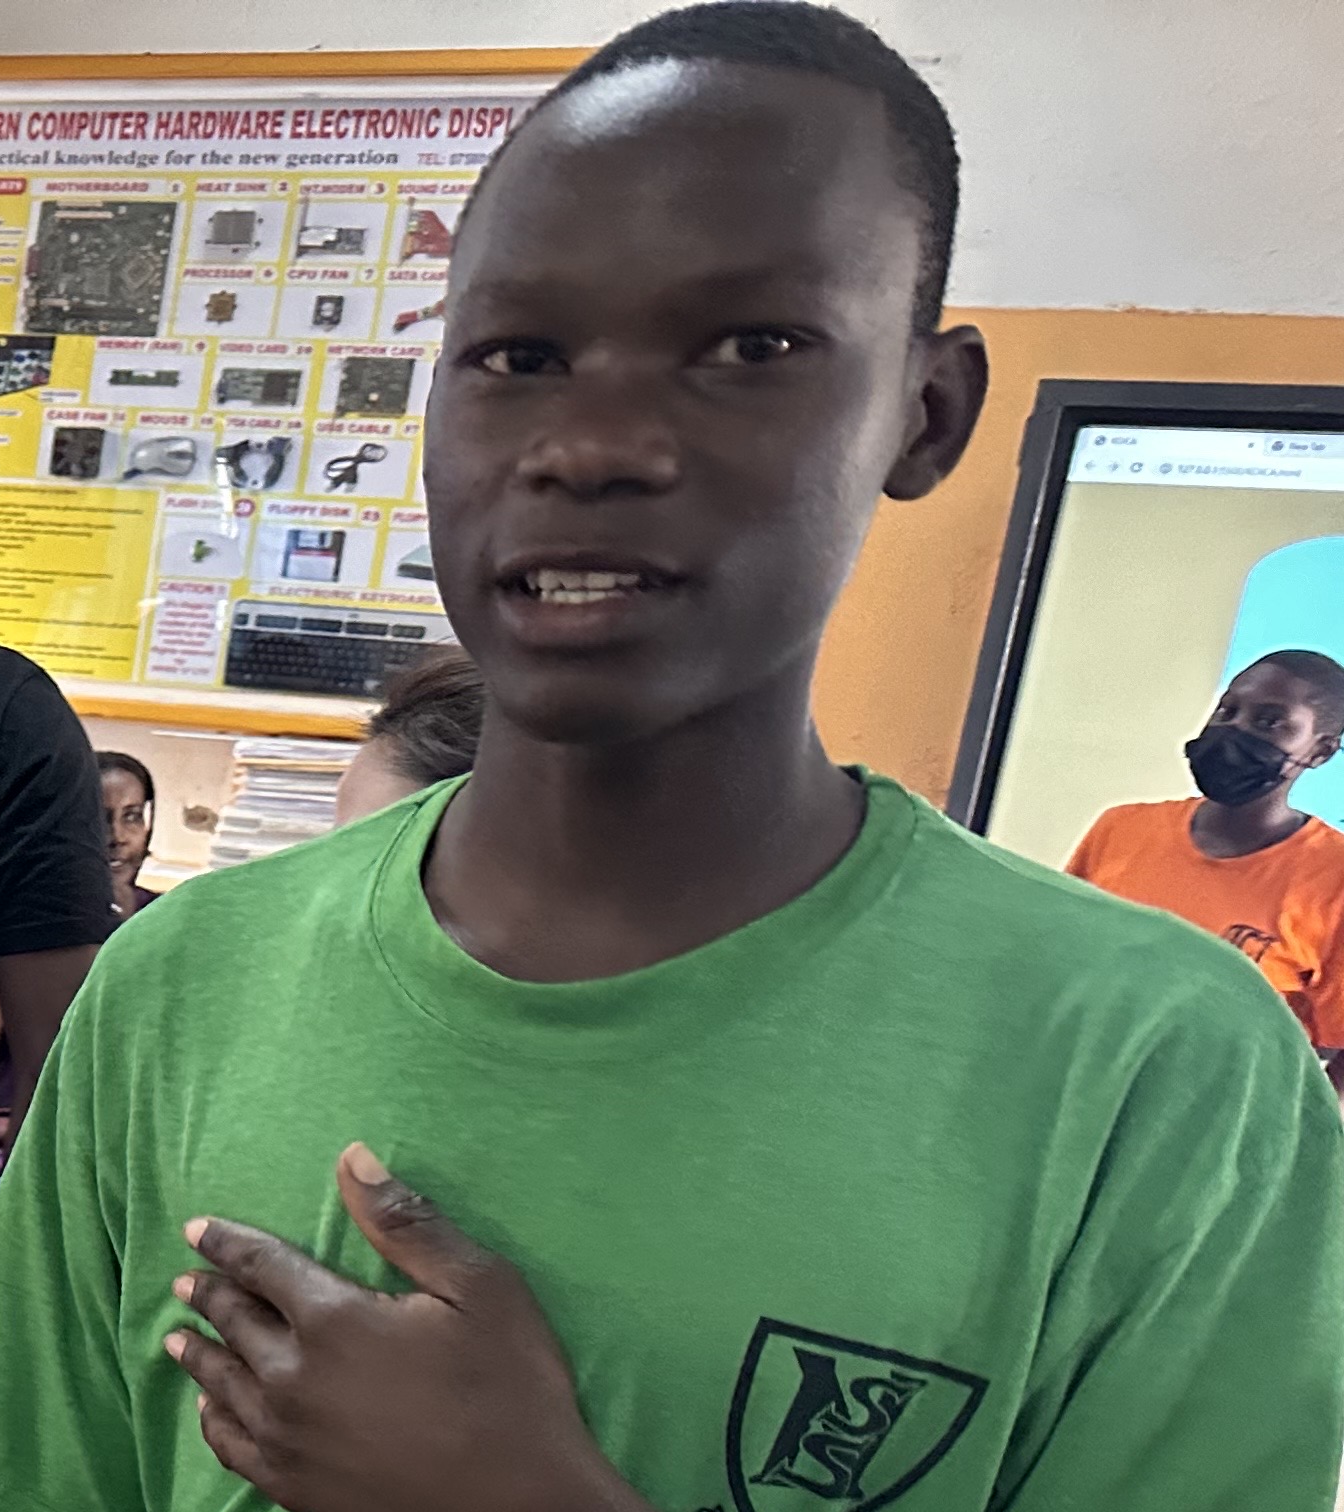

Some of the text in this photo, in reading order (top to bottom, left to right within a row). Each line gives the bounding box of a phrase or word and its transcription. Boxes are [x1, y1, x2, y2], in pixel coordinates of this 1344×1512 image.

[26, 111, 149, 141] COMPUTER
[153, 110, 285, 140] HARDWARE
[289, 107, 441, 139] ELECTRONIC
[54, 150, 159, 169] knowledge
[165, 150, 192, 166] for
[201, 150, 232, 166] the
[238, 153, 281, 165] new
[284, 150, 399, 168] generation
[45, 182, 150, 193] MOTHERBOARD
[195, 182, 233, 193] HEAT
[182, 268, 255, 279] PROCESSOR
[287, 269, 349, 280] CPU FAN
[139, 414, 189, 425] MOUSE
